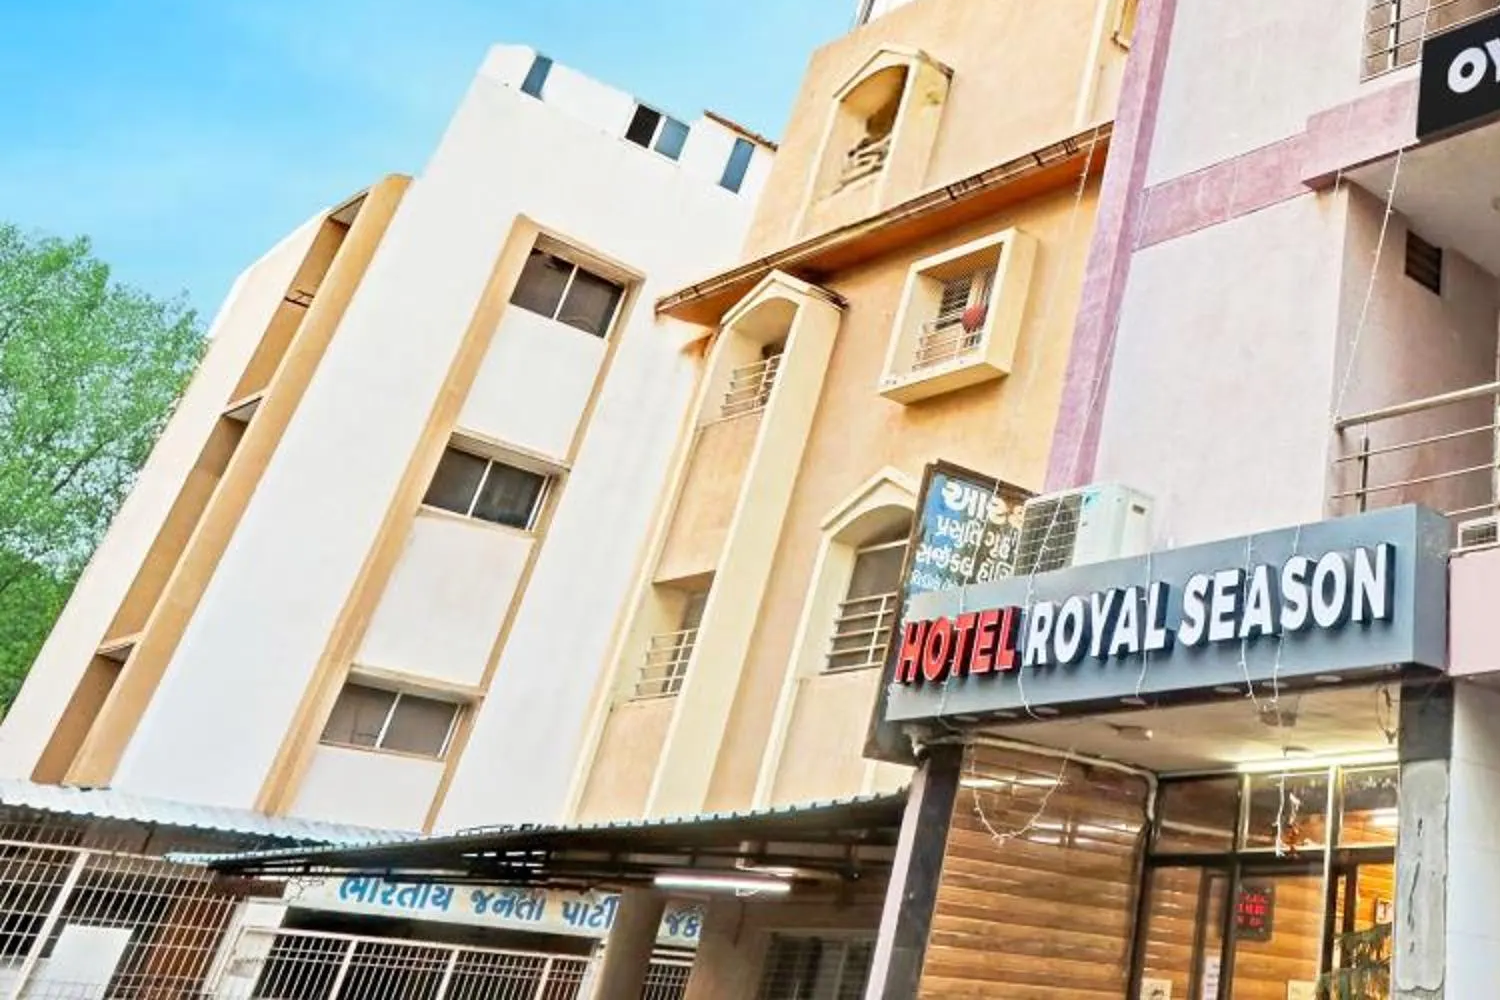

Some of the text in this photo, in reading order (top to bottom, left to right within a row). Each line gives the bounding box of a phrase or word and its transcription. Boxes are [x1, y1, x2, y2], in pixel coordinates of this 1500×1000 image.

[894, 543, 1389, 682] HOTEL ROYAL SEASON
[470, 888, 547, 921] જનતા
